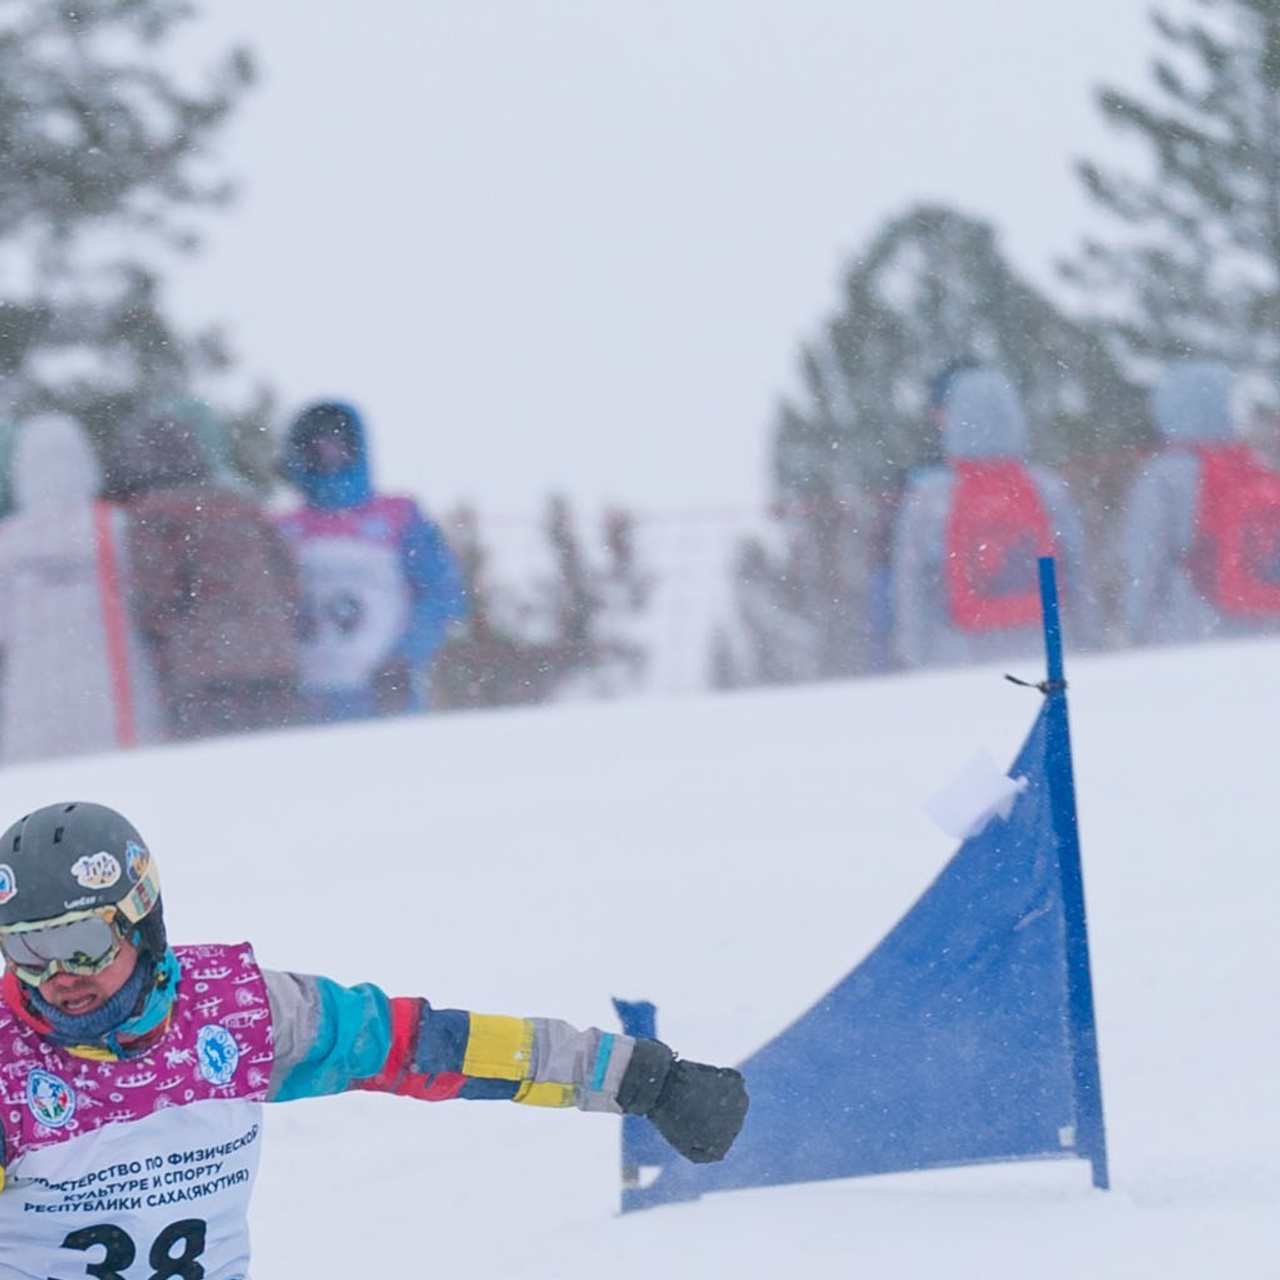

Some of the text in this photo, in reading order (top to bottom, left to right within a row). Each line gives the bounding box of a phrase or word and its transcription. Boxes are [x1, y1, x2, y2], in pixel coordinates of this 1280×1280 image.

[146, 1155, 164, 1172] ПО
[167, 1124, 259, 1166] ФИЗИЧЕСКОЙ
[23, 1168, 250, 1213] РЕСПУБЛИКИ САХА(ЯКУТИЯ)
[63, 1161, 224, 1202] КУЛЬТУРЕ И СПОРТУ
